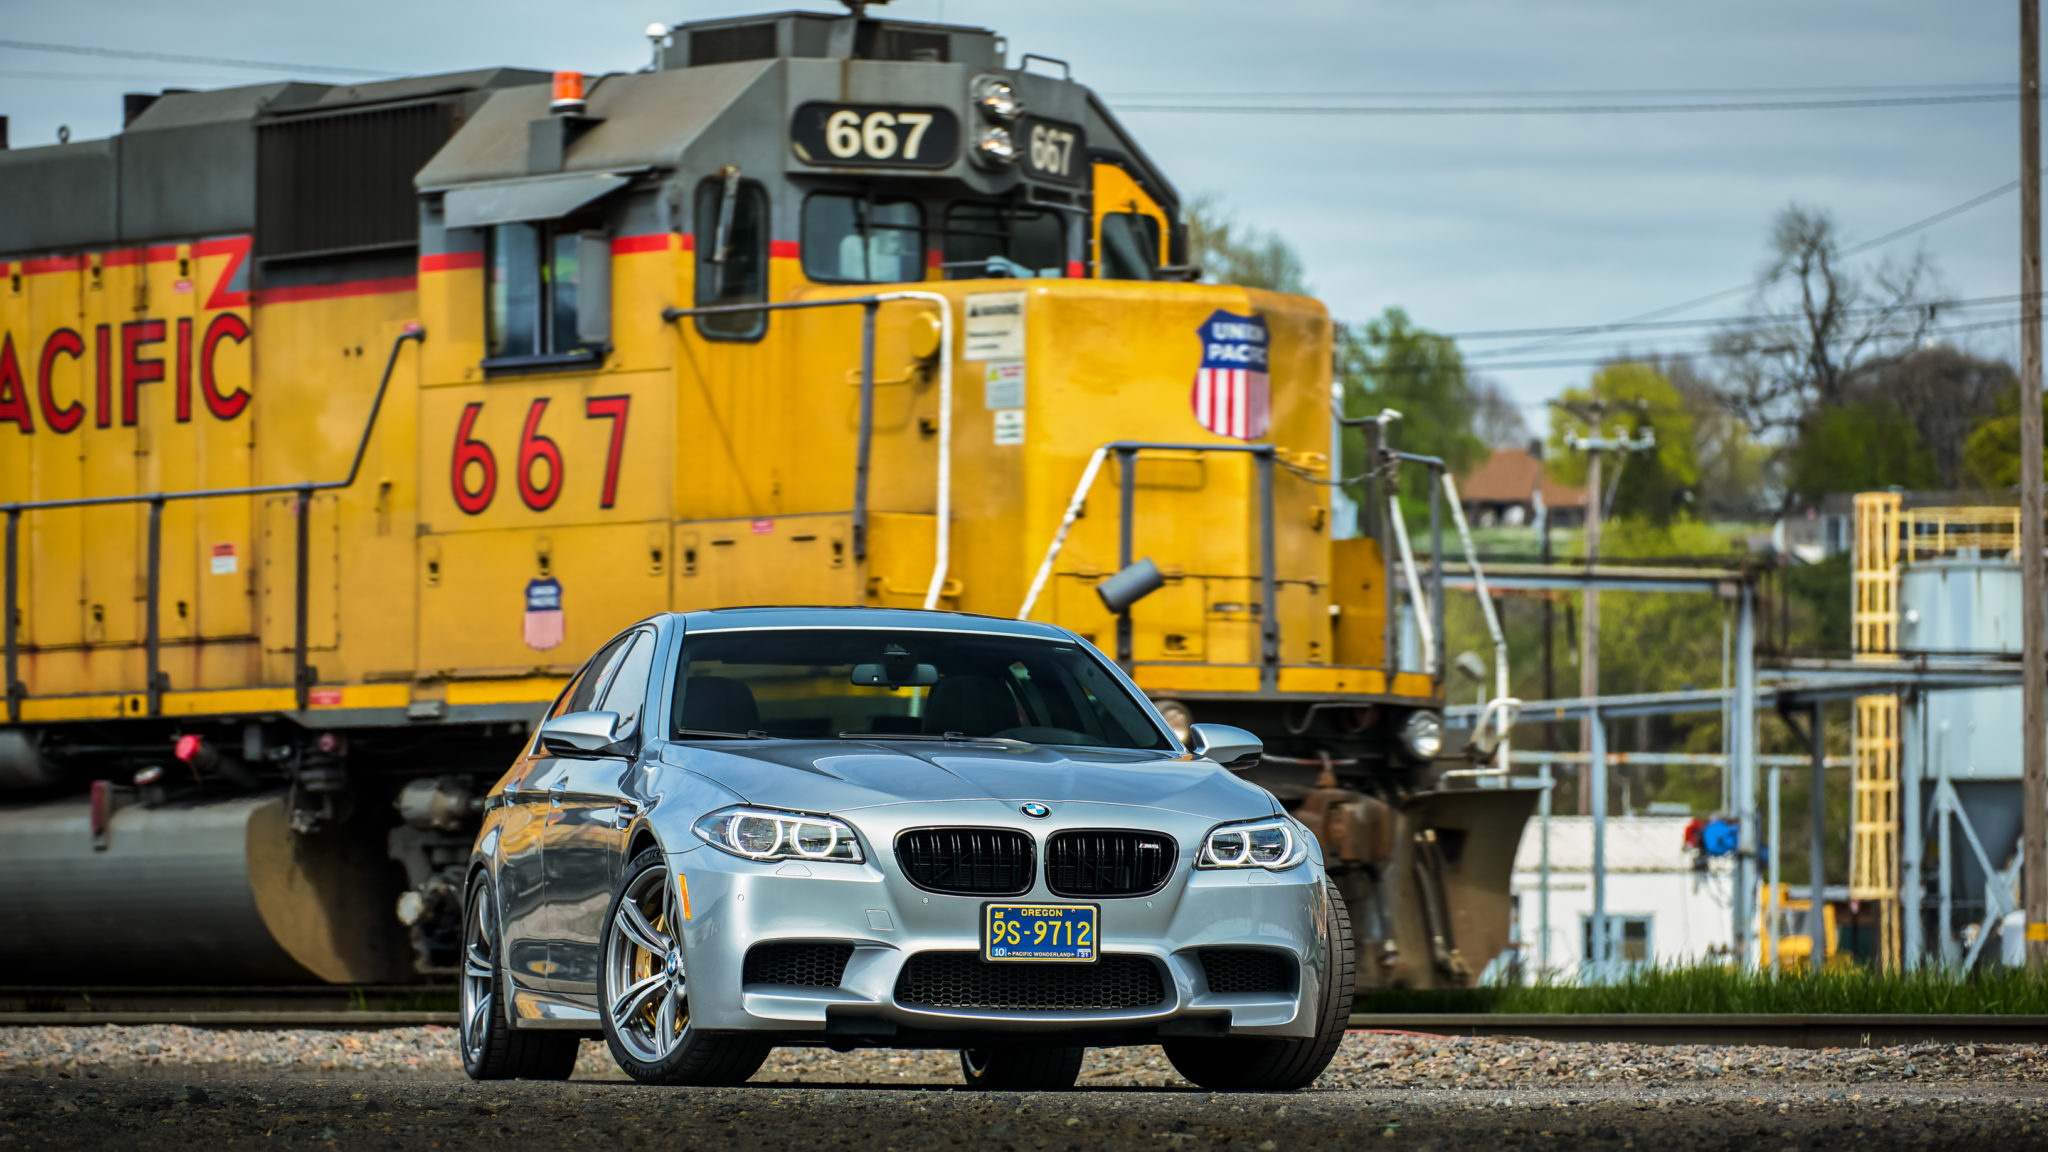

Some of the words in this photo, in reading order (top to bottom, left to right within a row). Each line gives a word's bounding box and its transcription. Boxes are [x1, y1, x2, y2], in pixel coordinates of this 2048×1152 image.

[826, 109, 933, 160] 667
[1030, 124, 1075, 176] 667
[450, 393, 632, 516] 667
[1021, 909, 1063, 917] OREGON
[992, 920, 1091, 945] 9S-9712
[994, 948, 1006, 957] 10
